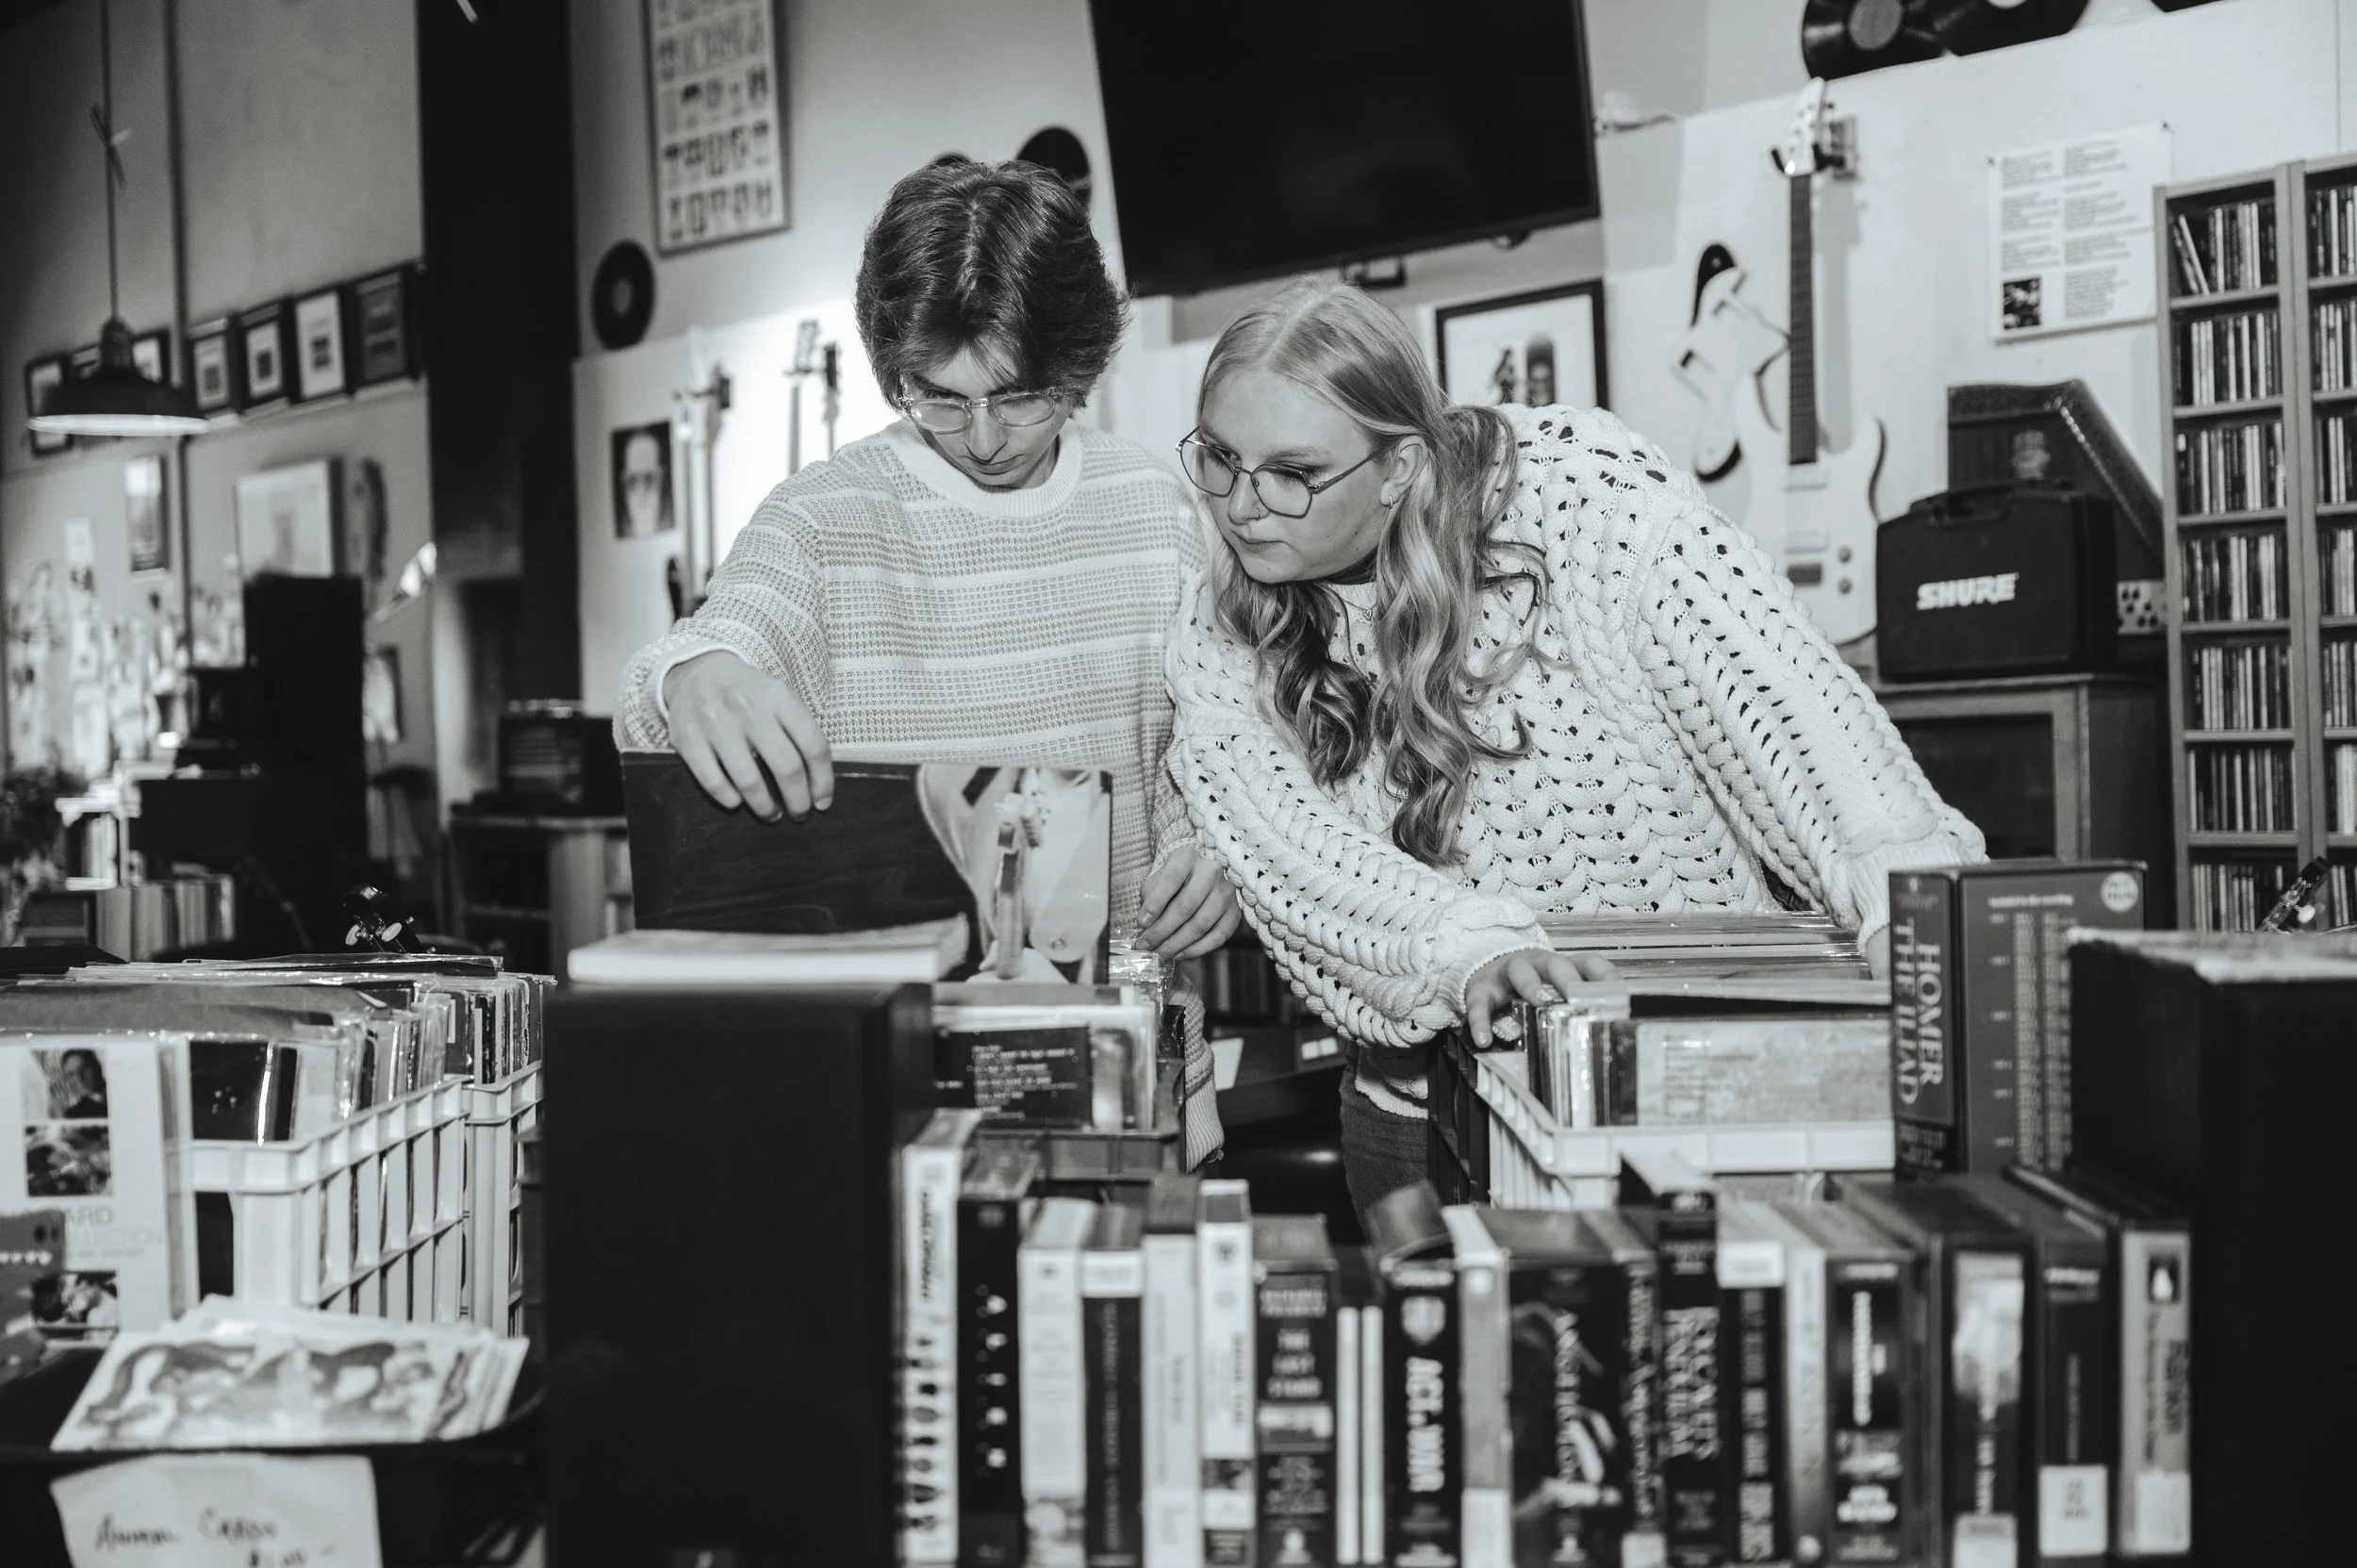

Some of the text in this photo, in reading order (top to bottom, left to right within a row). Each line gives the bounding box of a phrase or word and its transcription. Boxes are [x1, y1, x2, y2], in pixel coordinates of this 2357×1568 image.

[1916, 572, 2017, 611] SHURE
[1895, 917, 1918, 1105] THE ILIAD
[1918, 944, 1943, 1085] HOMER
